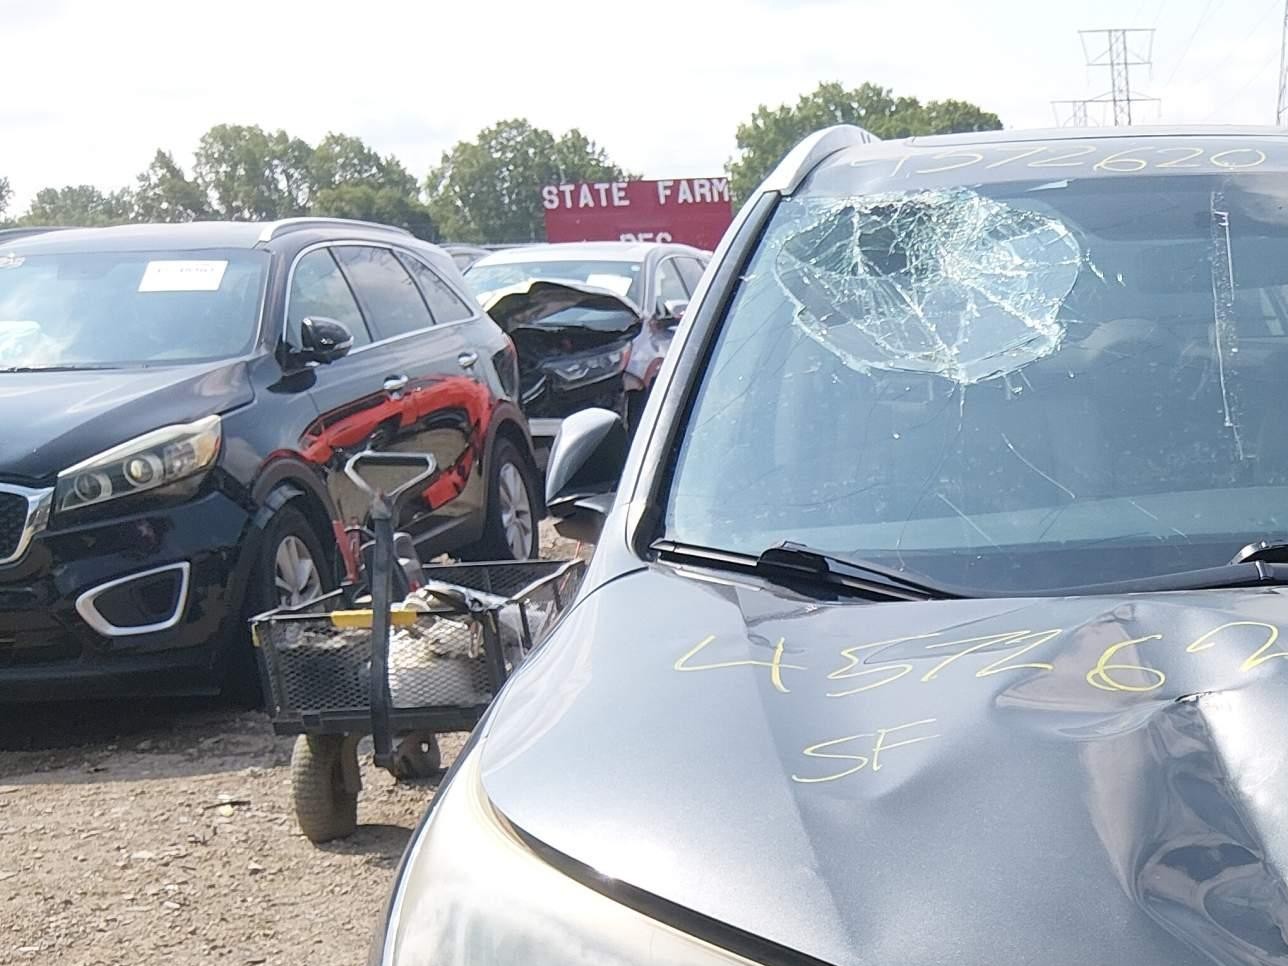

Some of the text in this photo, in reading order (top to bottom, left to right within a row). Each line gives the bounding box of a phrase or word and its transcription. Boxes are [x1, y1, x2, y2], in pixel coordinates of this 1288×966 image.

[542, 178, 730, 210] STATE FARM
[792, 718, 942, 783] SF
